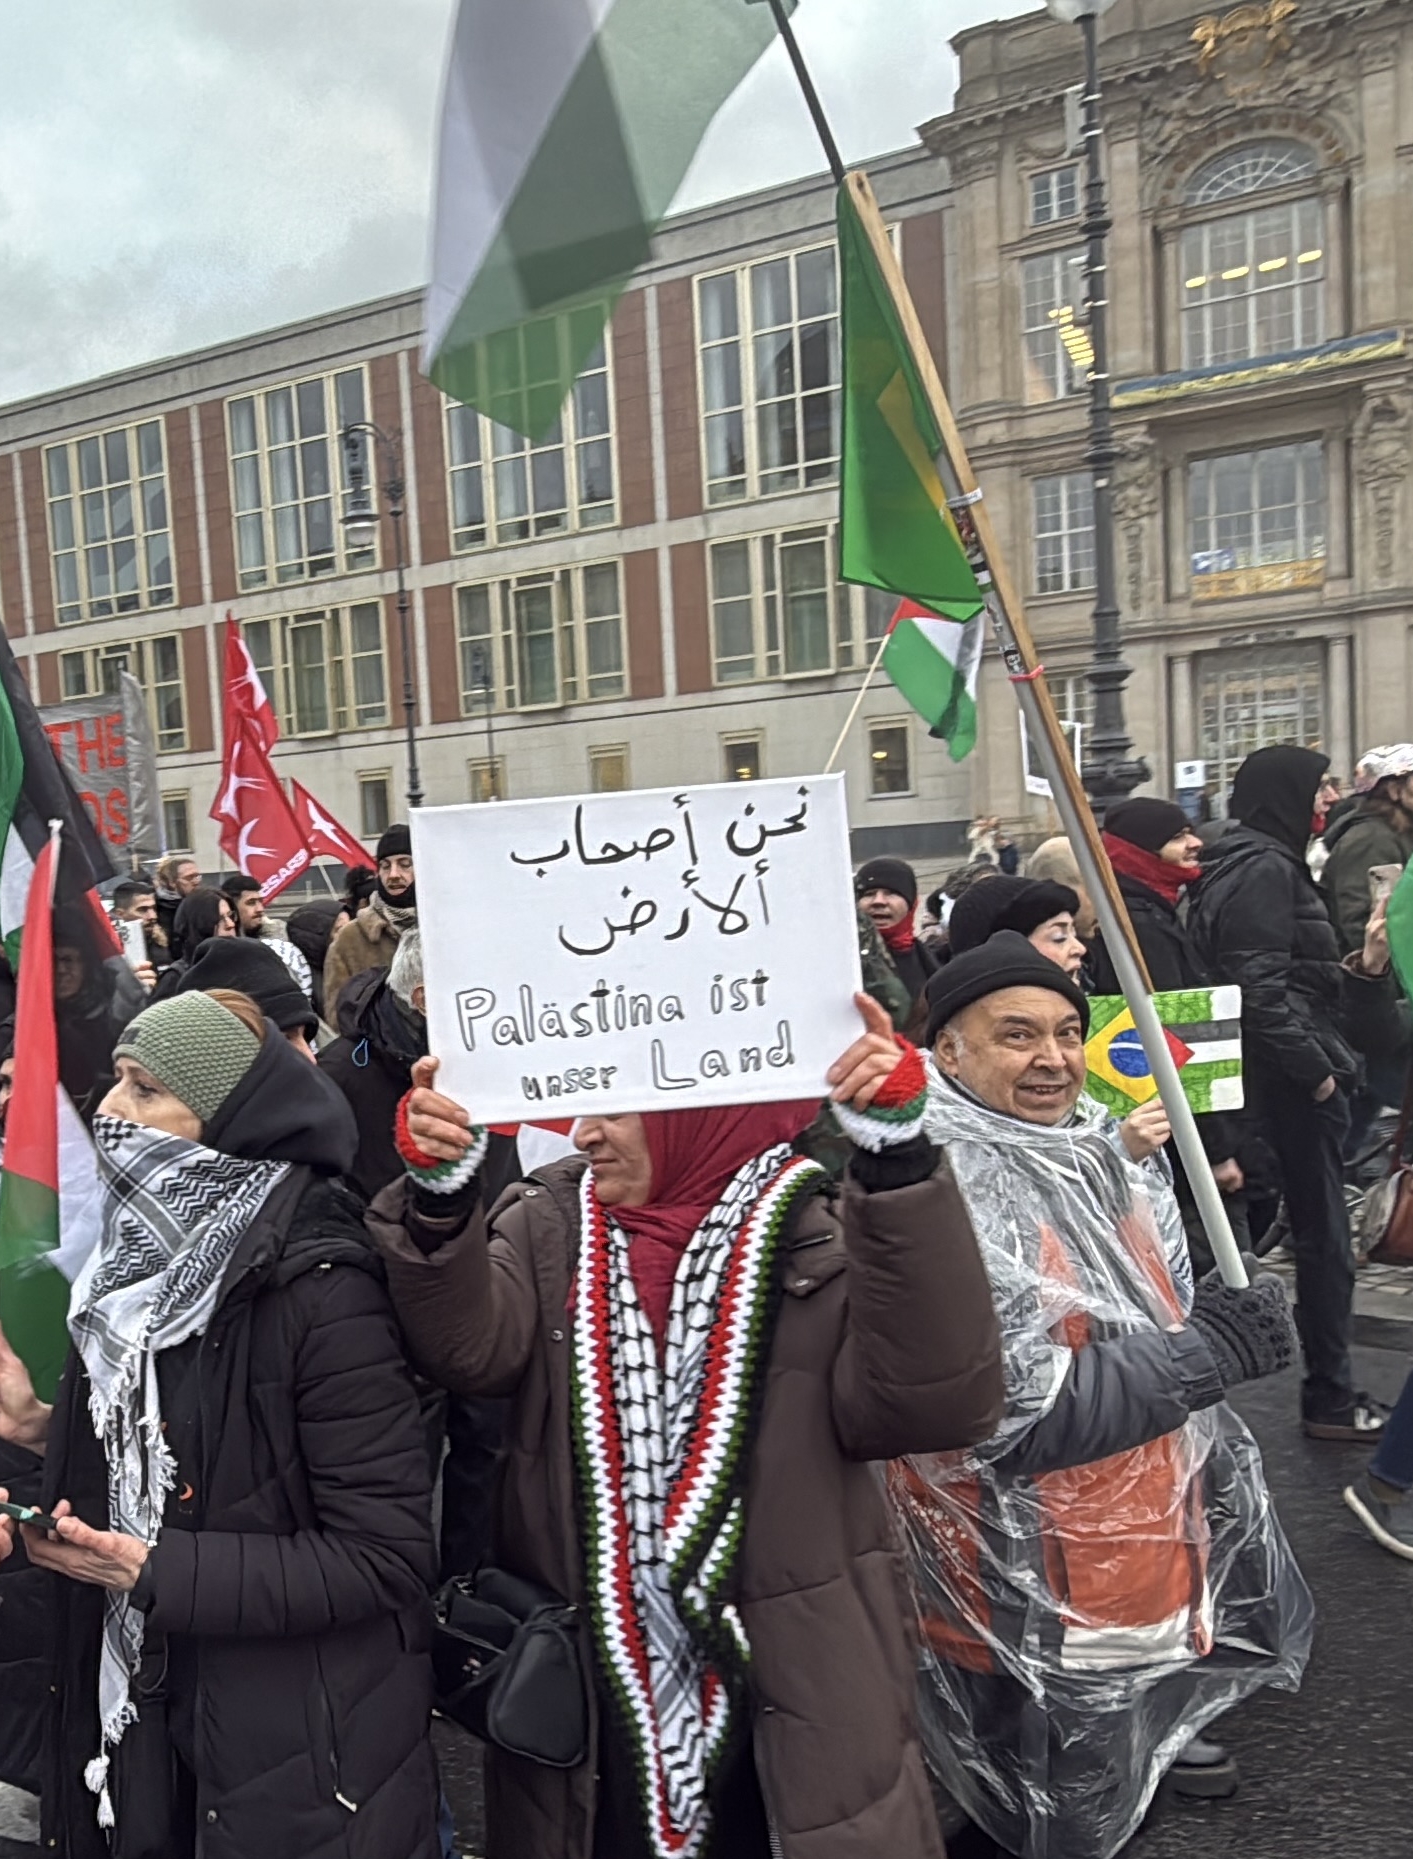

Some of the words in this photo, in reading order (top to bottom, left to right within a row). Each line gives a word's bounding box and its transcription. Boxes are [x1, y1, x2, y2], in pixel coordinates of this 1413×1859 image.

[44, 712, 127, 774] THE
[509, 792, 700, 878] أصحاب
[726, 785, 811, 857] نحن
[455, 978, 685, 1053] Palästina
[710, 969, 770, 1013] ist
[520, 1063, 618, 1102] unser
[650, 1018, 796, 1092] Land
